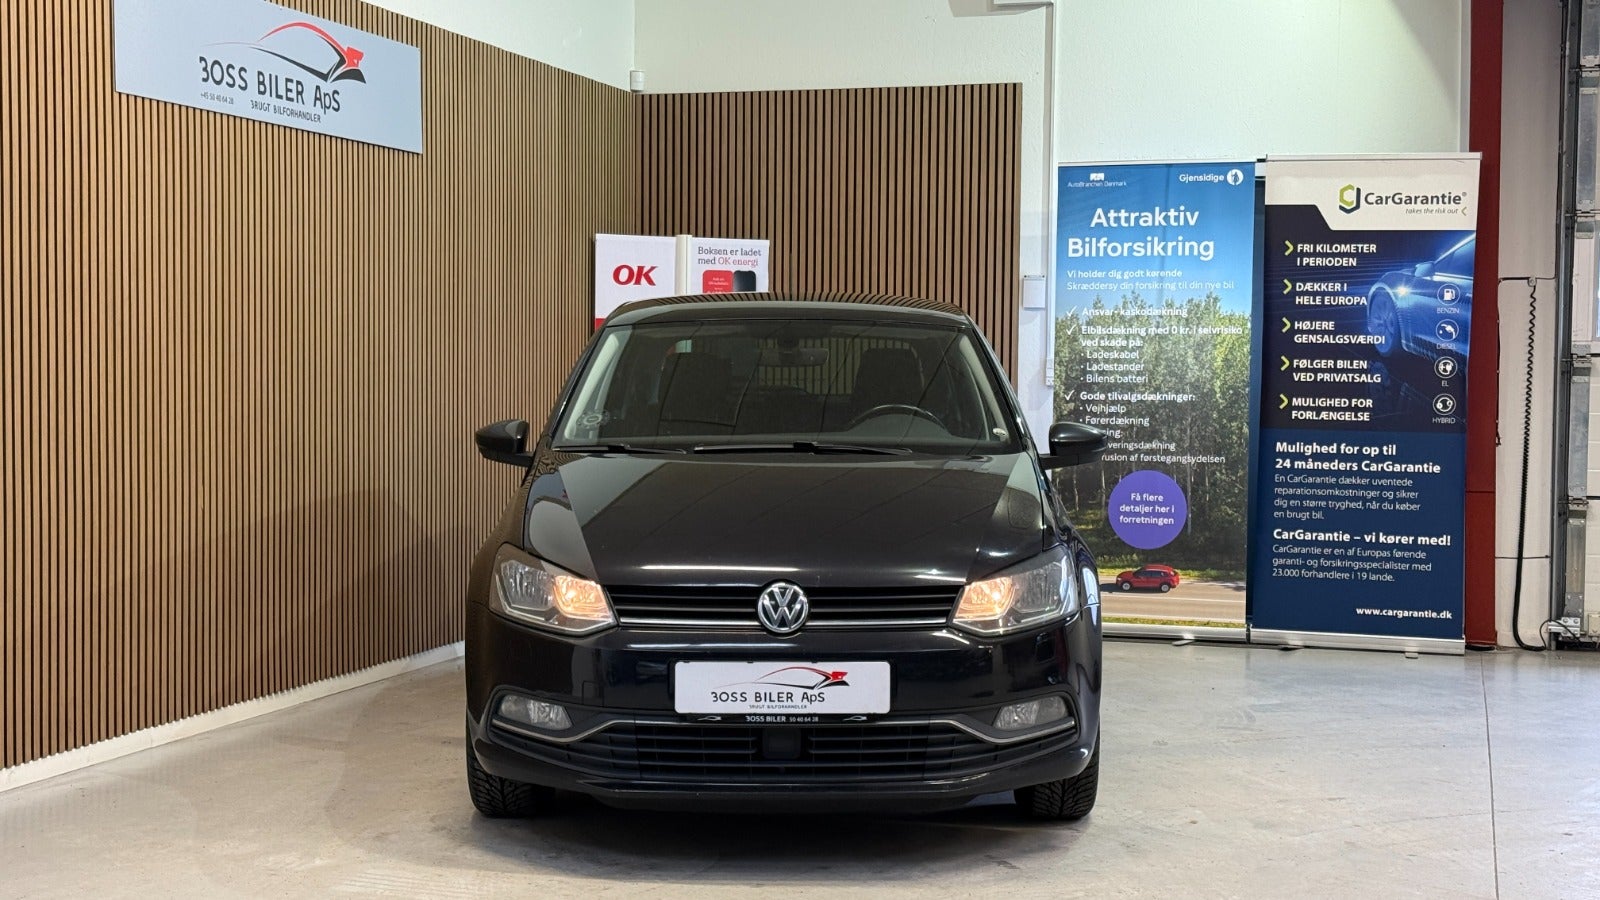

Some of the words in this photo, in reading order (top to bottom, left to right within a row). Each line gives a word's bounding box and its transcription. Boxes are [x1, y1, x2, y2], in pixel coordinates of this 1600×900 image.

[258, 71, 304, 104] BILER
[314, 86, 340, 114] ApS
[273, 105, 321, 122] BILFORHANDLER
[1179, 173, 1224, 184] Gjensidige
[1090, 206, 1199, 228] Attraktiv
[698, 247, 727, 256] Boksen
[741, 248, 761, 257] ladet
[1068, 236, 1214, 261] Bilforsikring
[1297, 244, 1313, 253] FRI
[1316, 244, 1376, 253] KILOMETER
[733, 259, 758, 268] energi
[1303, 258, 1356, 266] PERIODEN
[613, 264, 658, 286] OK
[1108, 270, 1122, 279] dig
[1124, 270, 1144, 278] godt
[1067, 282, 1118, 291] Skræddersy
[1136, 282, 1176, 290] forsikring
[1205, 282, 1221, 290] nye
[1296, 282, 1341, 292] DÆKKER
[1344, 282, 1347, 290] I
[1296, 296, 1322, 305] HELE
[1325, 296, 1367, 306] EUROPA
[1120, 308, 1188, 318] kaskodækning
[1294, 320, 1335, 331] HØJERE
[1082, 326, 1146, 336] Elbilsdækning
[1129, 339, 1143, 348] på:
[1294, 334, 1385, 344] GENSALGSVÆRDI
[1086, 350, 1139, 359] Ladeskabel
[1086, 363, 1144, 371] Ladestander
[1293, 359, 1334, 369] FØLGER
[1337, 360, 1367, 369] BILEN
[1086, 375, 1114, 383] Bilens
[1117, 375, 1148, 383] batteri
[1293, 373, 1314, 383] VED
[1317, 373, 1381, 383] PRIVATSALG
[1080, 392, 1106, 401] Gode
[1107, 392, 1196, 402] tilvalgsdækninger:
[1292, 397, 1349, 408] MULIGHED
[1351, 398, 1373, 408] FOR
[1085, 404, 1126, 414] Vejhjælp
[1291, 410, 1370, 421] FORLÆNGELSE
[1085, 416, 1150, 426] Førerdækning
[1108, 441, 1176, 451] veringsdækning
[1276, 442, 1337, 456] Mulighed
[1340, 444, 1359, 455] for
[1362, 446, 1380, 457] op
[1382, 444, 1396, 456] til
[1140, 454, 1226, 465] førstegangsydelsen
[1276, 459, 1291, 469] 24
[1294, 459, 1358, 471] måneders
[1361, 461, 1441, 474] CarGarantie
[1275, 474, 1285, 483] En
[1288, 475, 1336, 484] CarGarantie
[1338, 476, 1370, 485] dækker
[1372, 478, 1413, 487] uventede
[1131, 492, 1141, 501] Få
[1143, 493, 1164, 502] flere
[1275, 487, 1380, 499] reparationsomkostninger
[1382, 490, 1394, 499] og
[1396, 489, 1418, 499] sikrer
[1120, 504, 1152, 514] detaljer
[1274, 499, 1288, 508] dig
[1303, 499, 1326, 508] større
[1328, 500, 1364, 510] tryghed,
[1366, 500, 1380, 509] når
[1382, 501, 1394, 510] du
[1396, 502, 1420, 511] køber
[1120, 516, 1174, 526] forretningen
[1287, 511, 1310, 521] brugt
[1312, 511, 1324, 519] bil.
[1273, 529, 1350, 542] CarGarantie
[1364, 532, 1375, 543] vi
[1379, 533, 1413, 545] kører
[1417, 534, 1451, 546] med!
[1273, 545, 1322, 554] CarGarantie
[1347, 547, 1355, 556] af
[1357, 548, 1391, 558] Europas
[1393, 549, 1427, 559] førende
[1273, 557, 1305, 567] garanti-
[1307, 559, 1318, 568] og
[1320, 558, 1409, 571] forsikringsspecialister
[1412, 562, 1432, 571] med
[1272, 569, 1300, 577] 23.000
[1301, 570, 1349, 580] forhandlere
[1351, 571, 1354, 579] i
[1357, 572, 1367, 581] 19
[1369, 572, 1395, 582] lande.
[1356, 607, 1452, 619] www.cargarantie.dk
[755, 692, 794, 702] BILER
[801, 692, 825, 704] ApS
